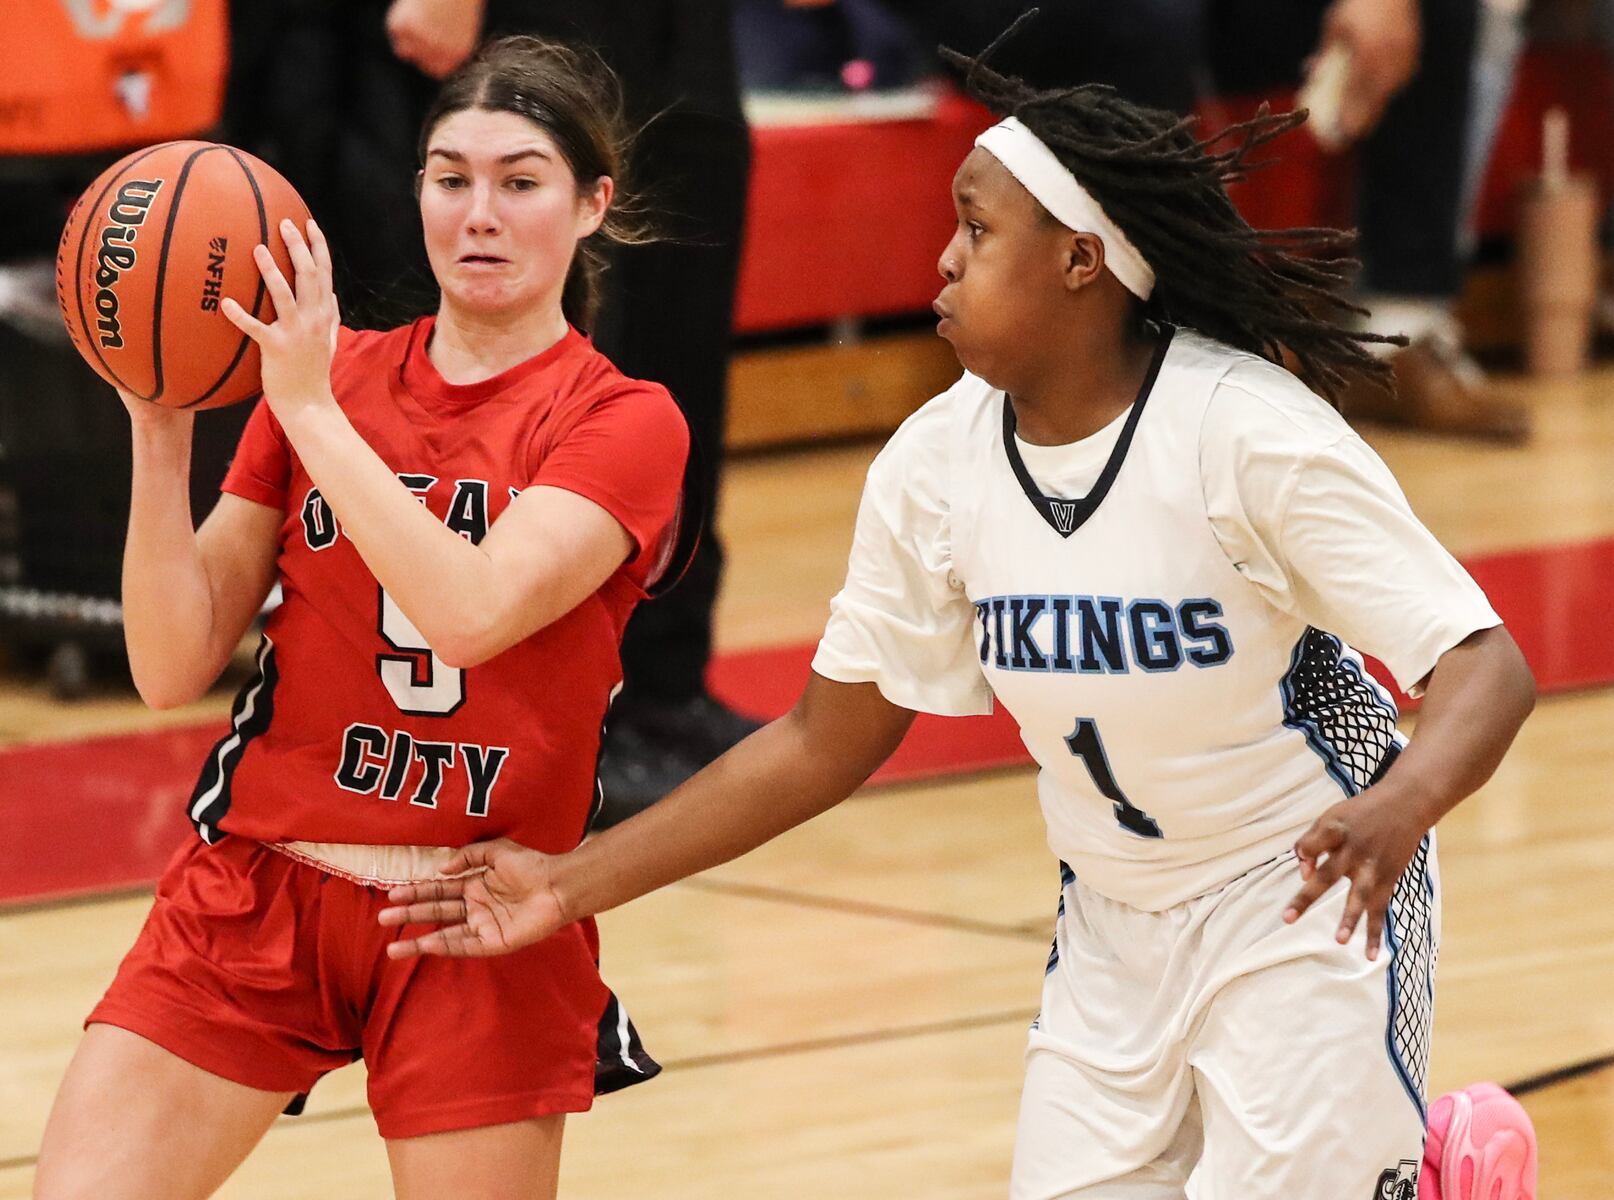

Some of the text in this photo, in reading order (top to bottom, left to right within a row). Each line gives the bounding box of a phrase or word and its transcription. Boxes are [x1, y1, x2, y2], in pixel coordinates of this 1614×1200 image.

[94, 177, 165, 350] Wilson
[200, 252, 227, 313] NFHS
[333, 721, 510, 817] CITY
[1063, 717, 1164, 839] 1
